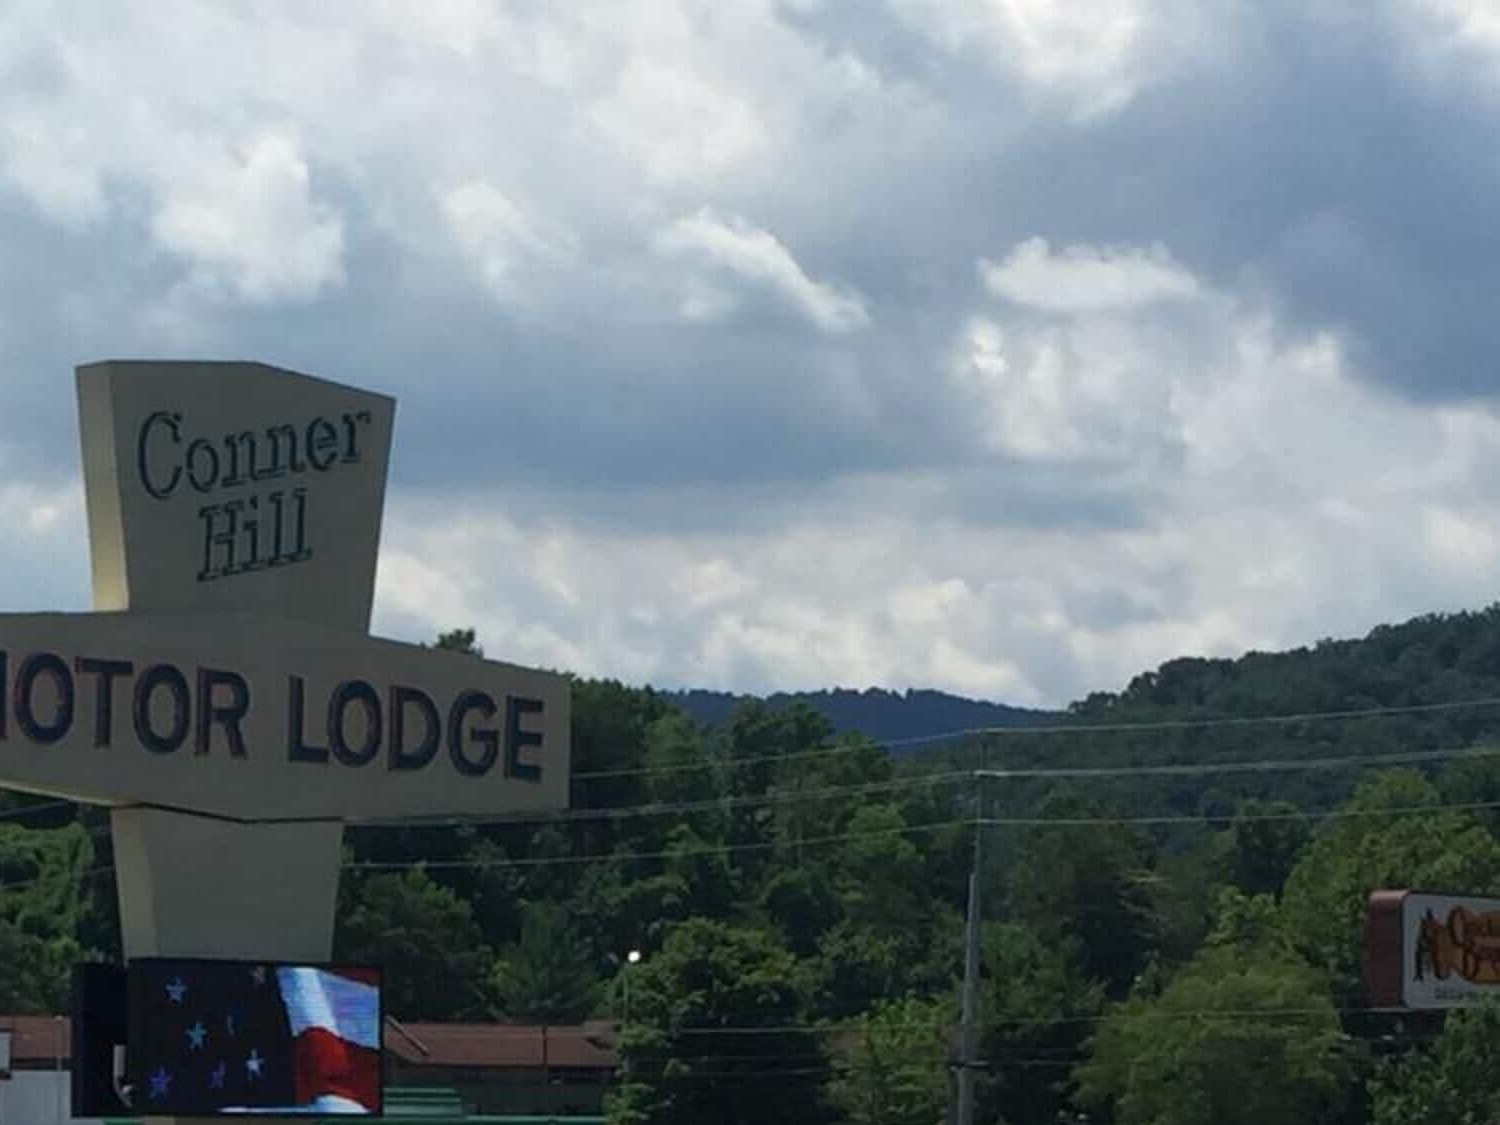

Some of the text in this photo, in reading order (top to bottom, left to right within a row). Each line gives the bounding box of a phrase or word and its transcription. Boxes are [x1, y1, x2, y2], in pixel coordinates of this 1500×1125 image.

[138, 410, 371, 499] Conner
[196, 488, 313, 583] Hill
[288, 674, 544, 783] LODGE
